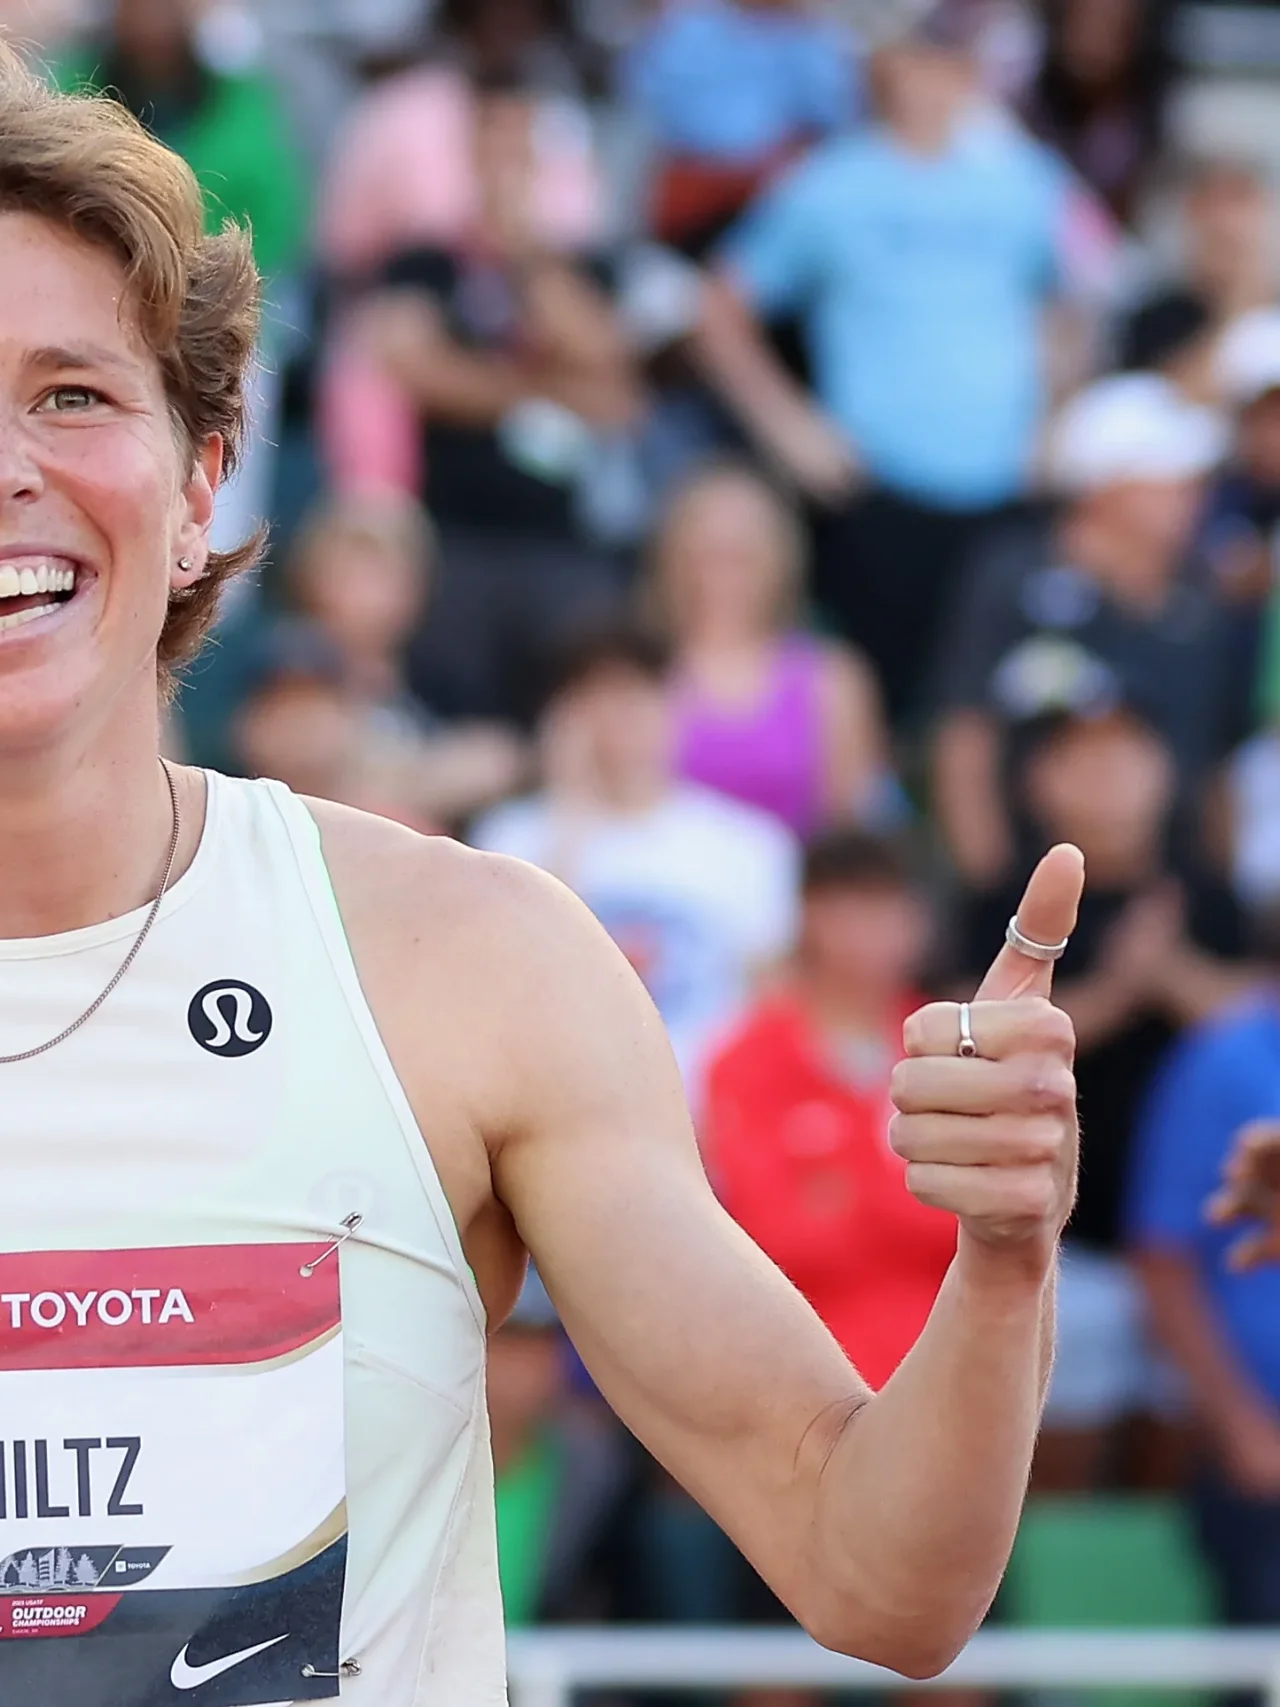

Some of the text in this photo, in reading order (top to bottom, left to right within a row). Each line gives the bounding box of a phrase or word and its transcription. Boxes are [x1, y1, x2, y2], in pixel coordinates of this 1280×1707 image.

[1, 1288, 195, 1329] TOYOTA
[127, 1562, 151, 1570] TOYOTA
[12, 1606, 86, 1620] OUTDOOR
[12, 1618, 80, 1628] CHAMPIONSHIPS
